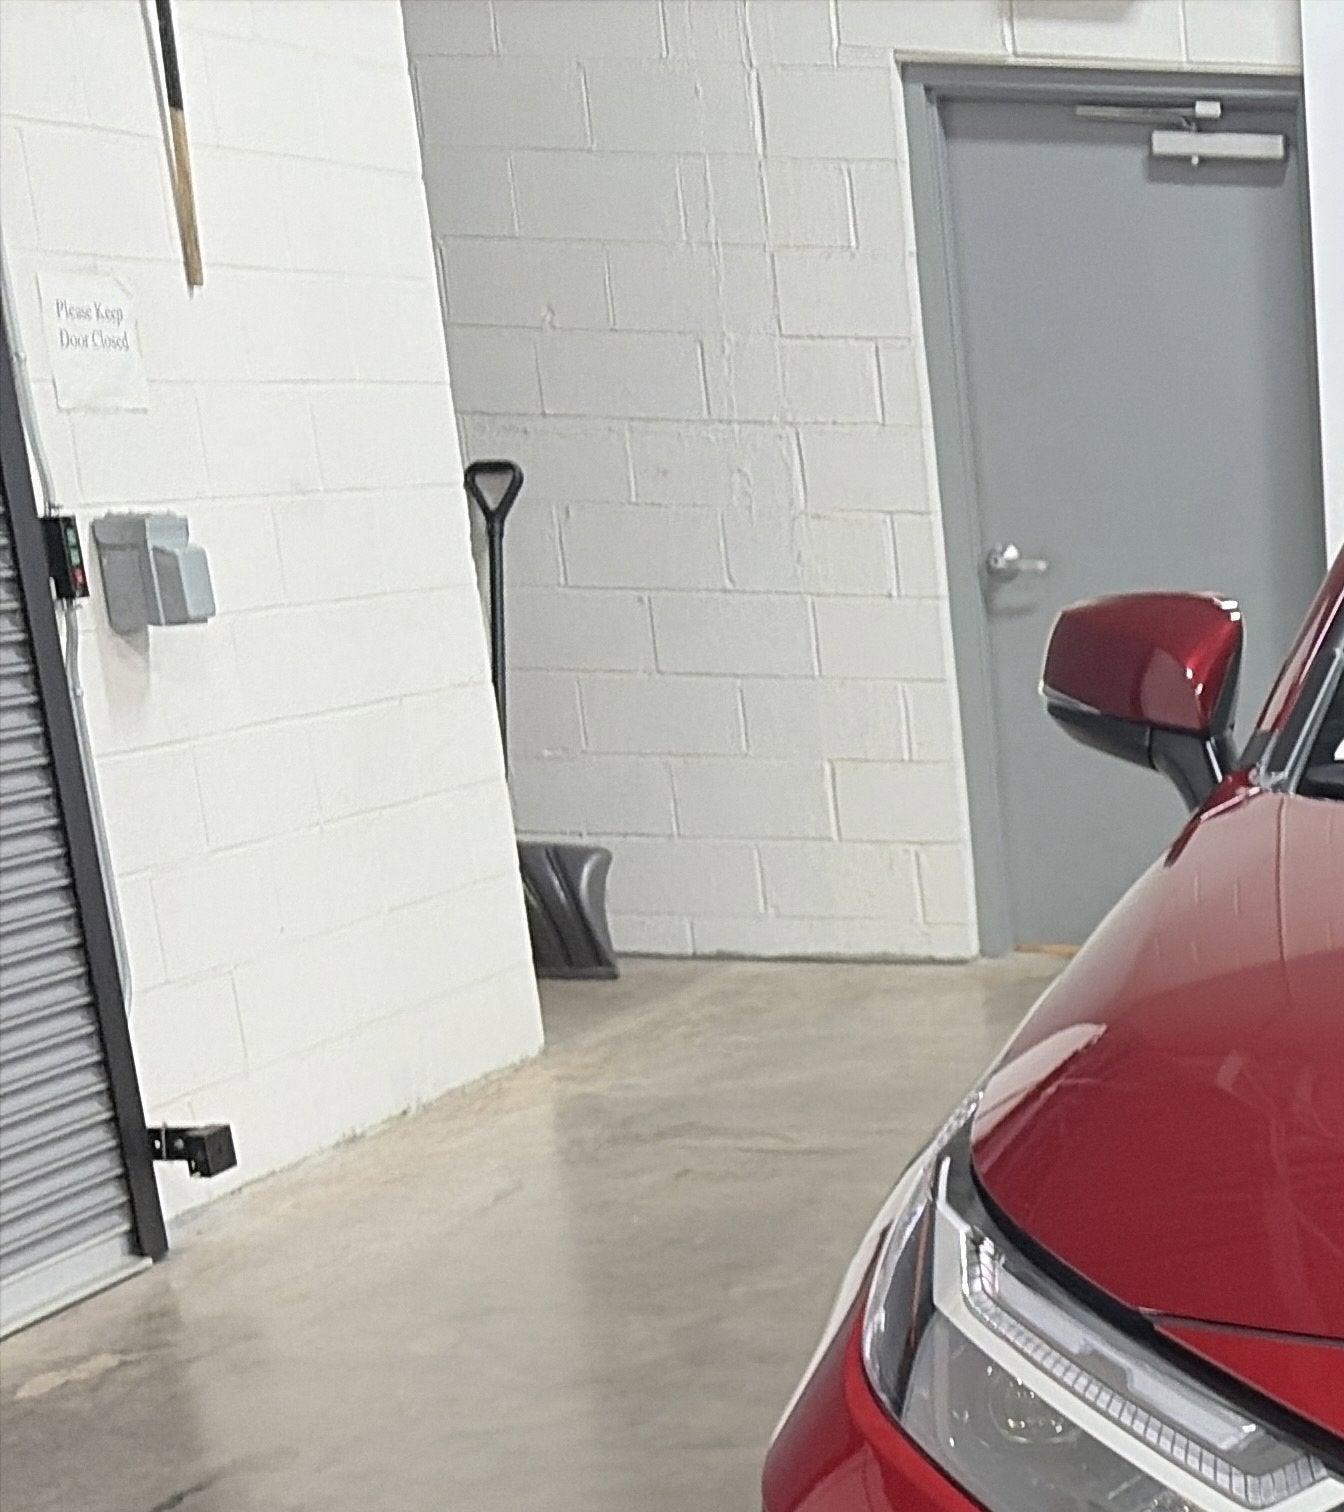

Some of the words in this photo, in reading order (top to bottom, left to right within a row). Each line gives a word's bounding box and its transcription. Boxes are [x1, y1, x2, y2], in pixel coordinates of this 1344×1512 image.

[55, 298, 92, 321] Please
[94, 301, 123, 326] Keep
[60, 327, 89, 349] Door
[92, 329, 130, 351] Closed
